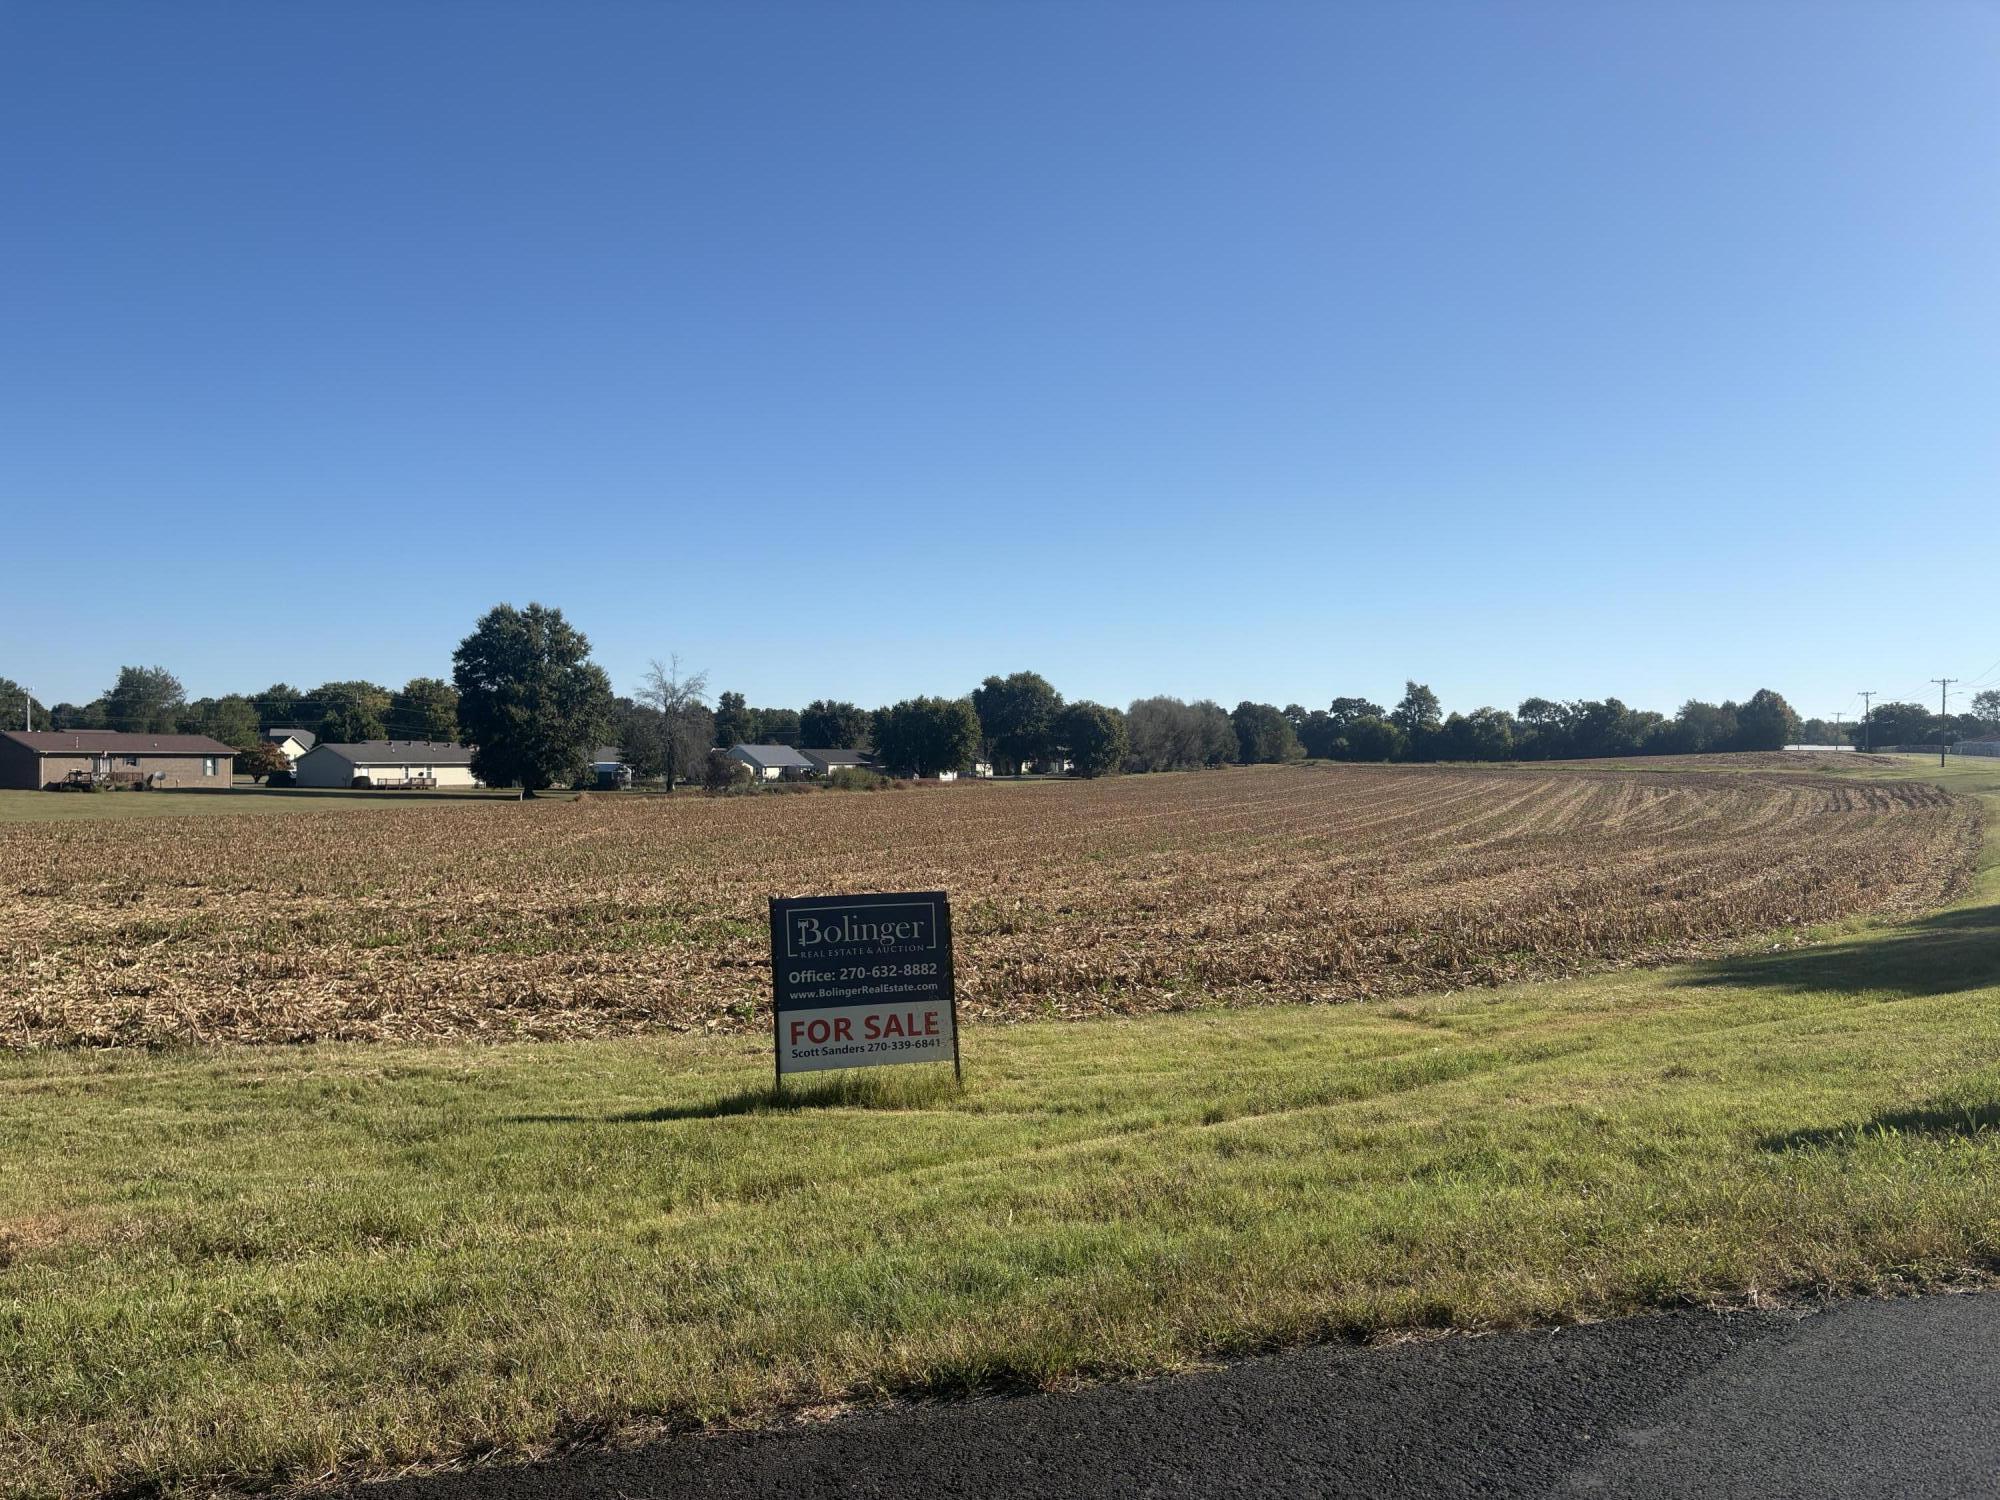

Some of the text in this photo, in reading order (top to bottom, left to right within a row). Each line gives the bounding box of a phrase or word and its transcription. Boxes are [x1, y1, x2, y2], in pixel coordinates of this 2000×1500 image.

[797, 914, 925, 946] Bolinger
[800, 950, 825, 959] REAL
[828, 948, 866, 957] ESTATE
[876, 944, 925, 954] AUCTION
[788, 963, 938, 984] Office: 270-632-8882
[789, 982, 939, 999] www.BolingerRealEstate.com
[790, 1011, 940, 1046] FOR SALE
[791, 1038, 941, 1059] Scott Sanders 270-339-6841
